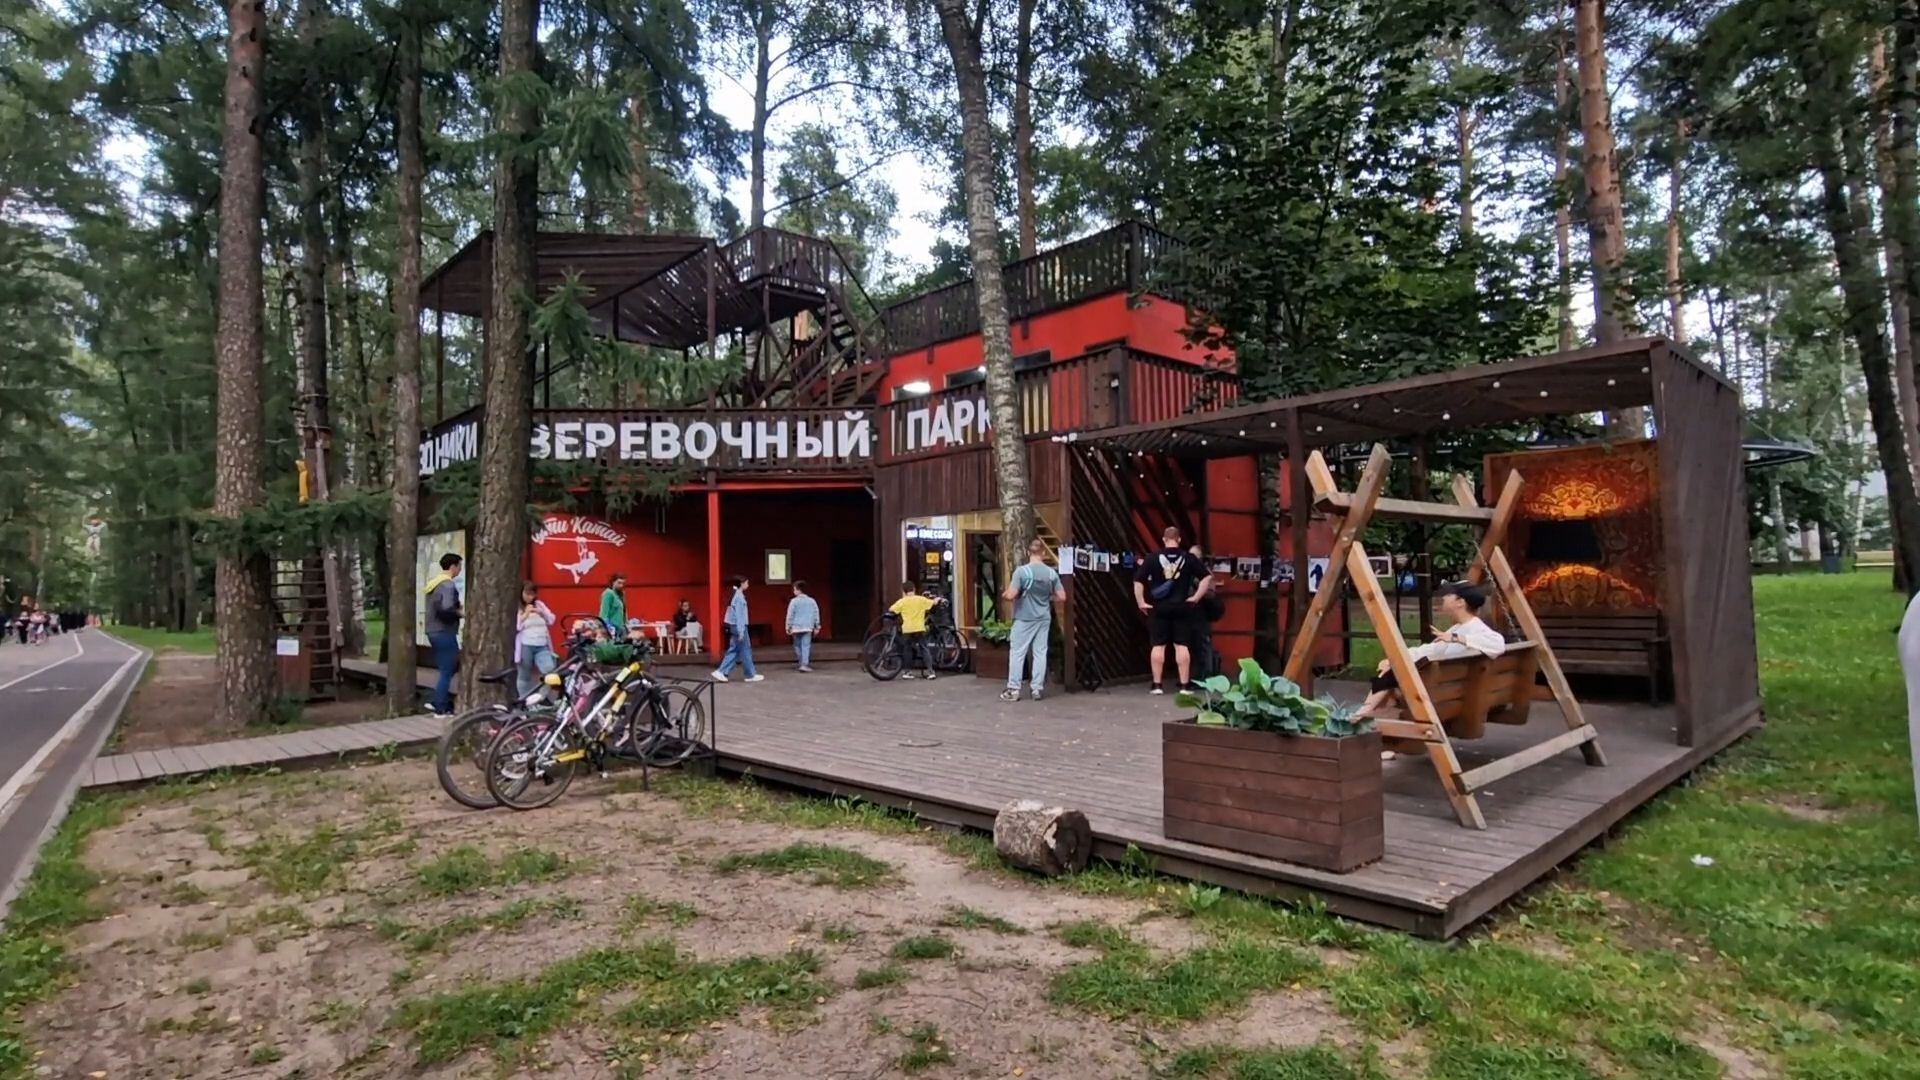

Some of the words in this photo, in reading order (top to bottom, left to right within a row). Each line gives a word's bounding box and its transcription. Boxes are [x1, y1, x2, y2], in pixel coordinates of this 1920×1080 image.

[529, 411, 870, 459] ВЕРЕВОЧНЫЙ
[907, 398, 992, 450] ПАРК
[570, 516, 627, 547] Катай
